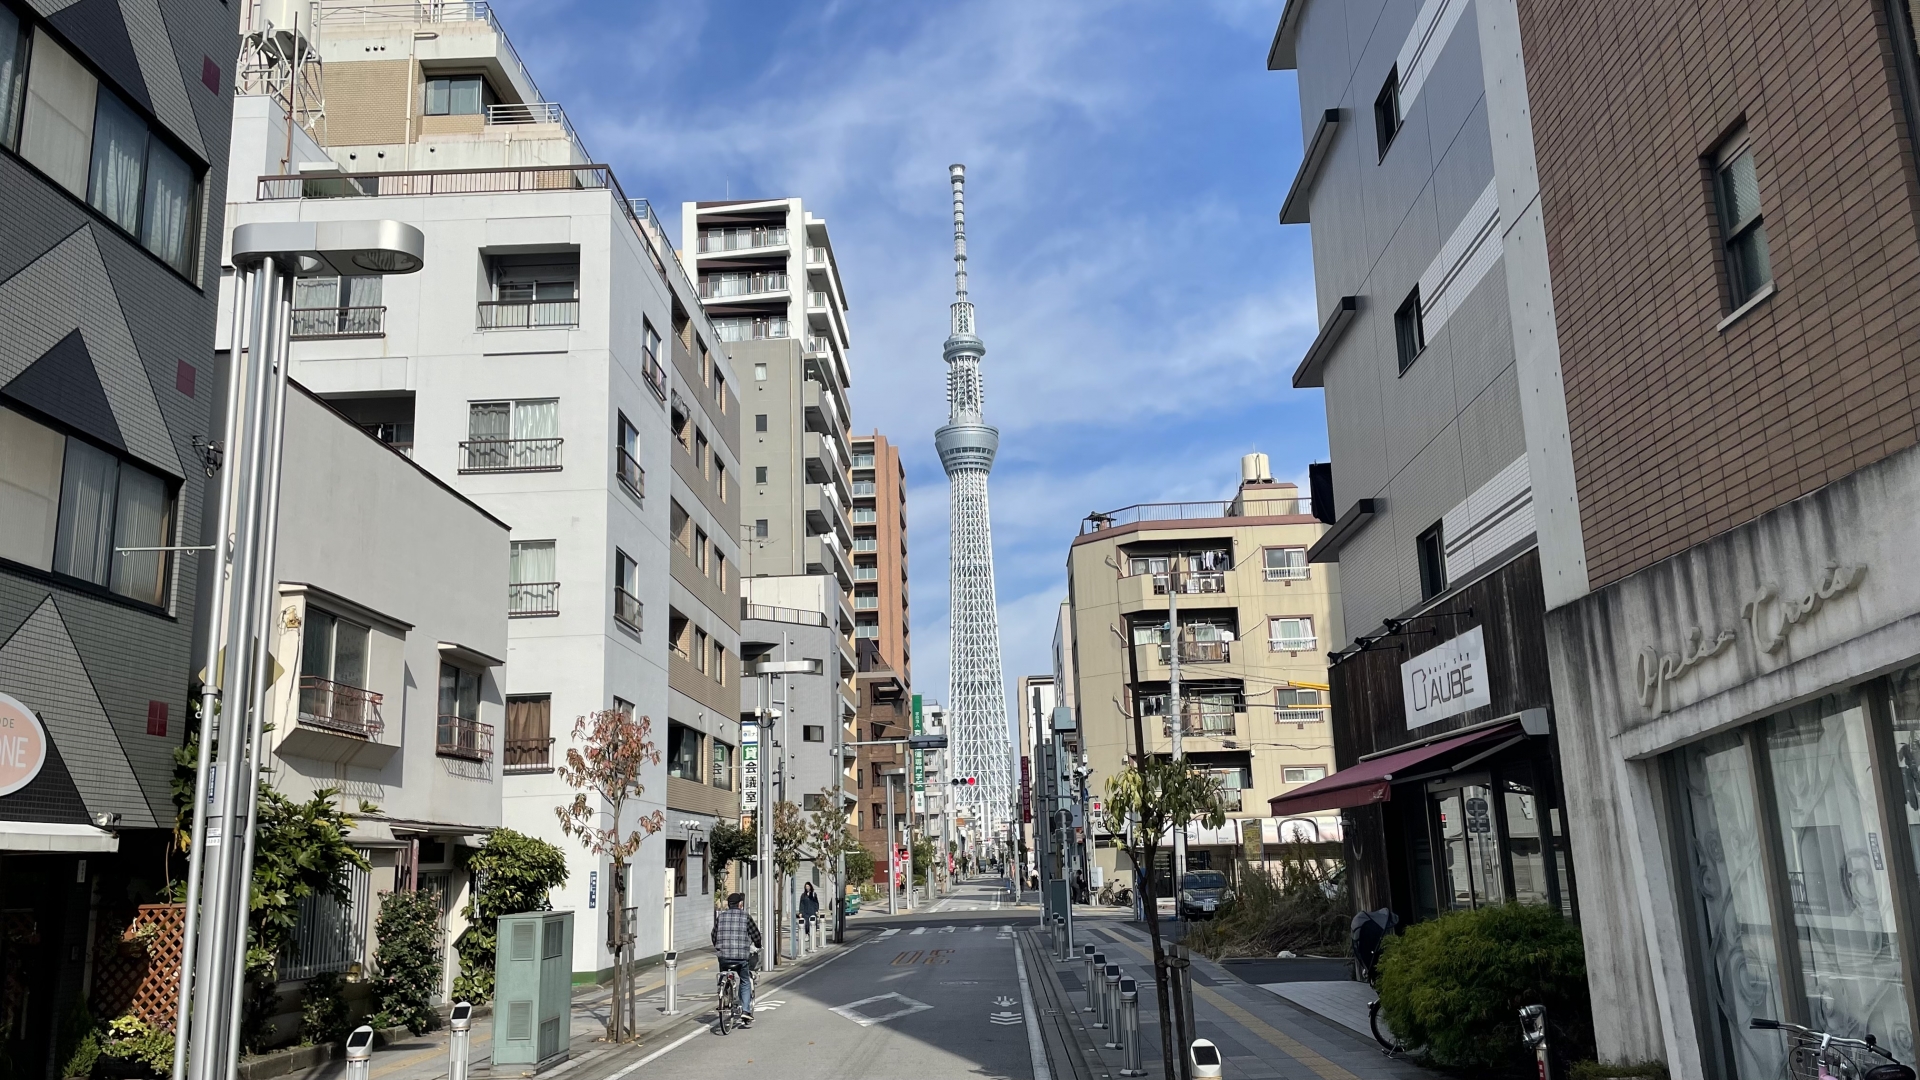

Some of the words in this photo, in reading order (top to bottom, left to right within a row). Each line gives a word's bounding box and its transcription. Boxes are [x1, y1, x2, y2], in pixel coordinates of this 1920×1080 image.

[1429, 662, 1447, 675] hair
[1454, 652, 1470, 665] sky
[1430, 663, 1475, 707] AUBE
[0, 717, 15, 729] DE
[0, 734, 29, 768] NE
[745, 746, 758, 803] 貸会議室
